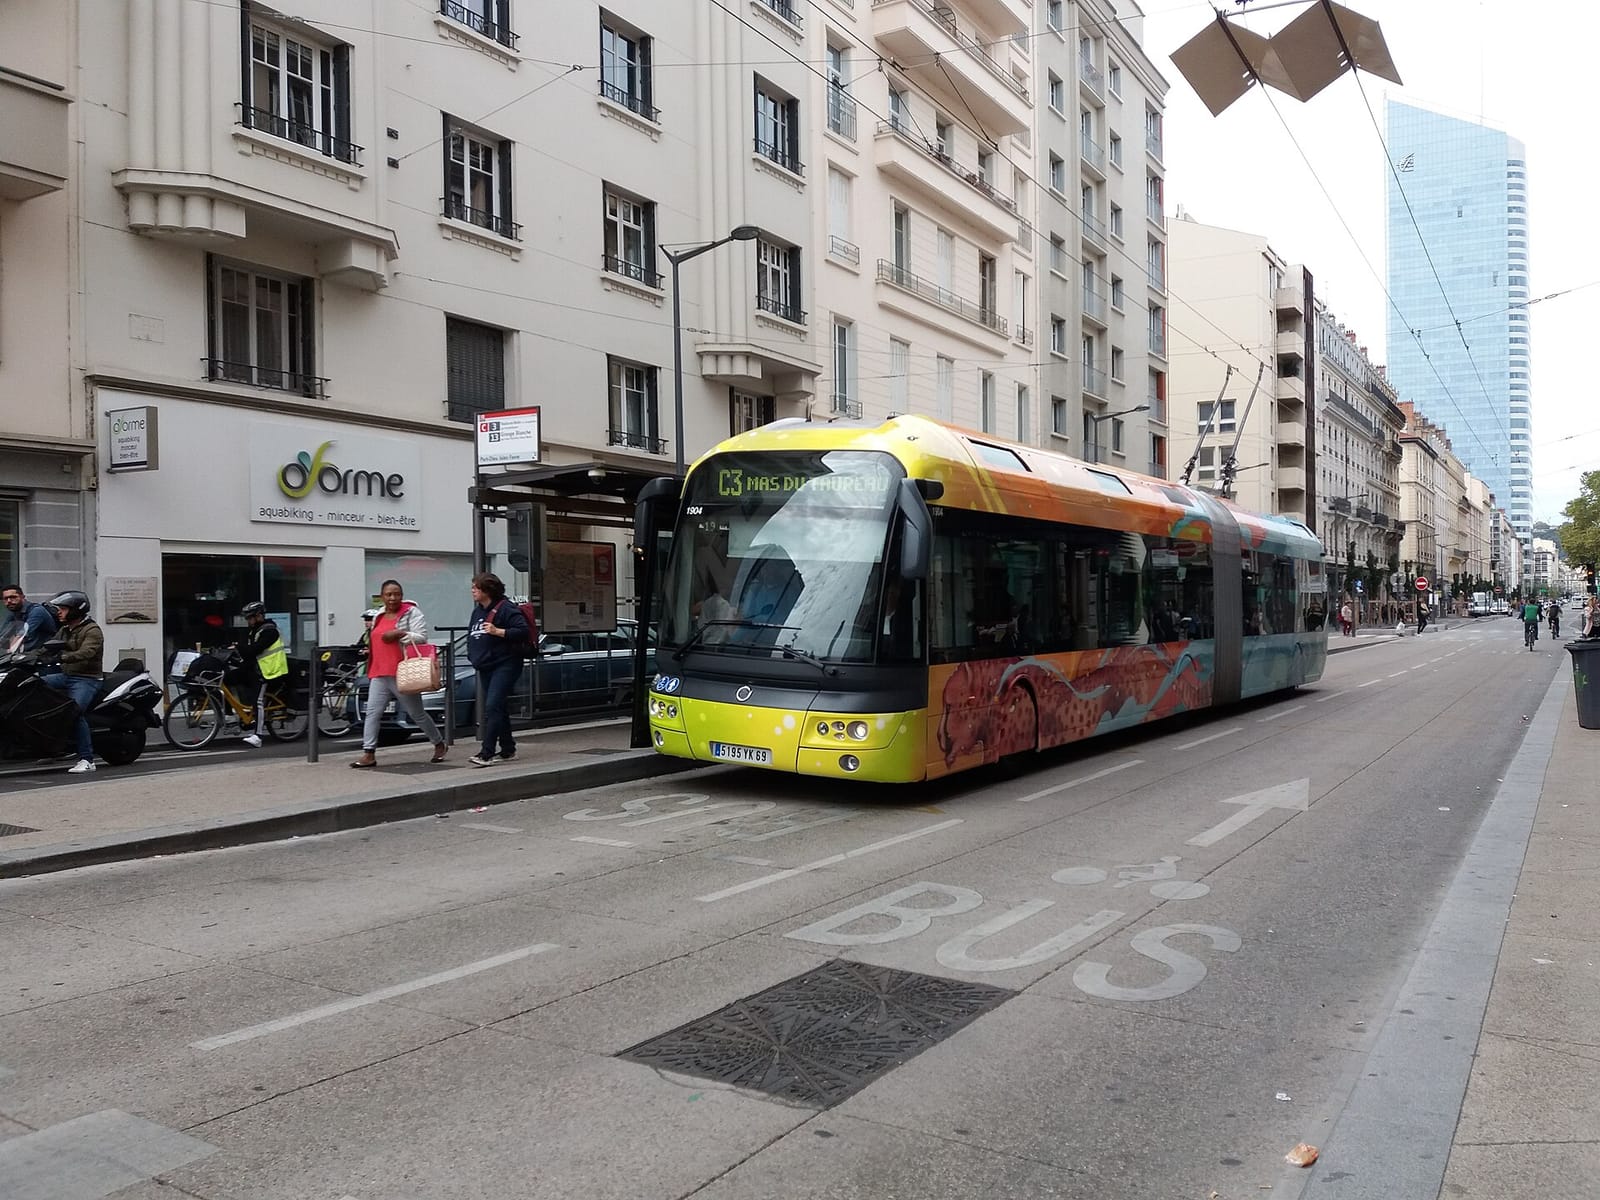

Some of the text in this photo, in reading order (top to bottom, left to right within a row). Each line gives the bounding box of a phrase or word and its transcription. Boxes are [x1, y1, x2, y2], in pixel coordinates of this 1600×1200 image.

[718, 469, 891, 497] C3 MAS DU TAUREAU
[259, 506, 314, 521] aquabiking
[327, 510, 365, 522] minceur
[377, 513, 416, 526] bien-être
[686, 506, 703, 515] 1904
[721, 745, 767, 762] 5195 YK 69
[782, 881, 1243, 1002] BUS
